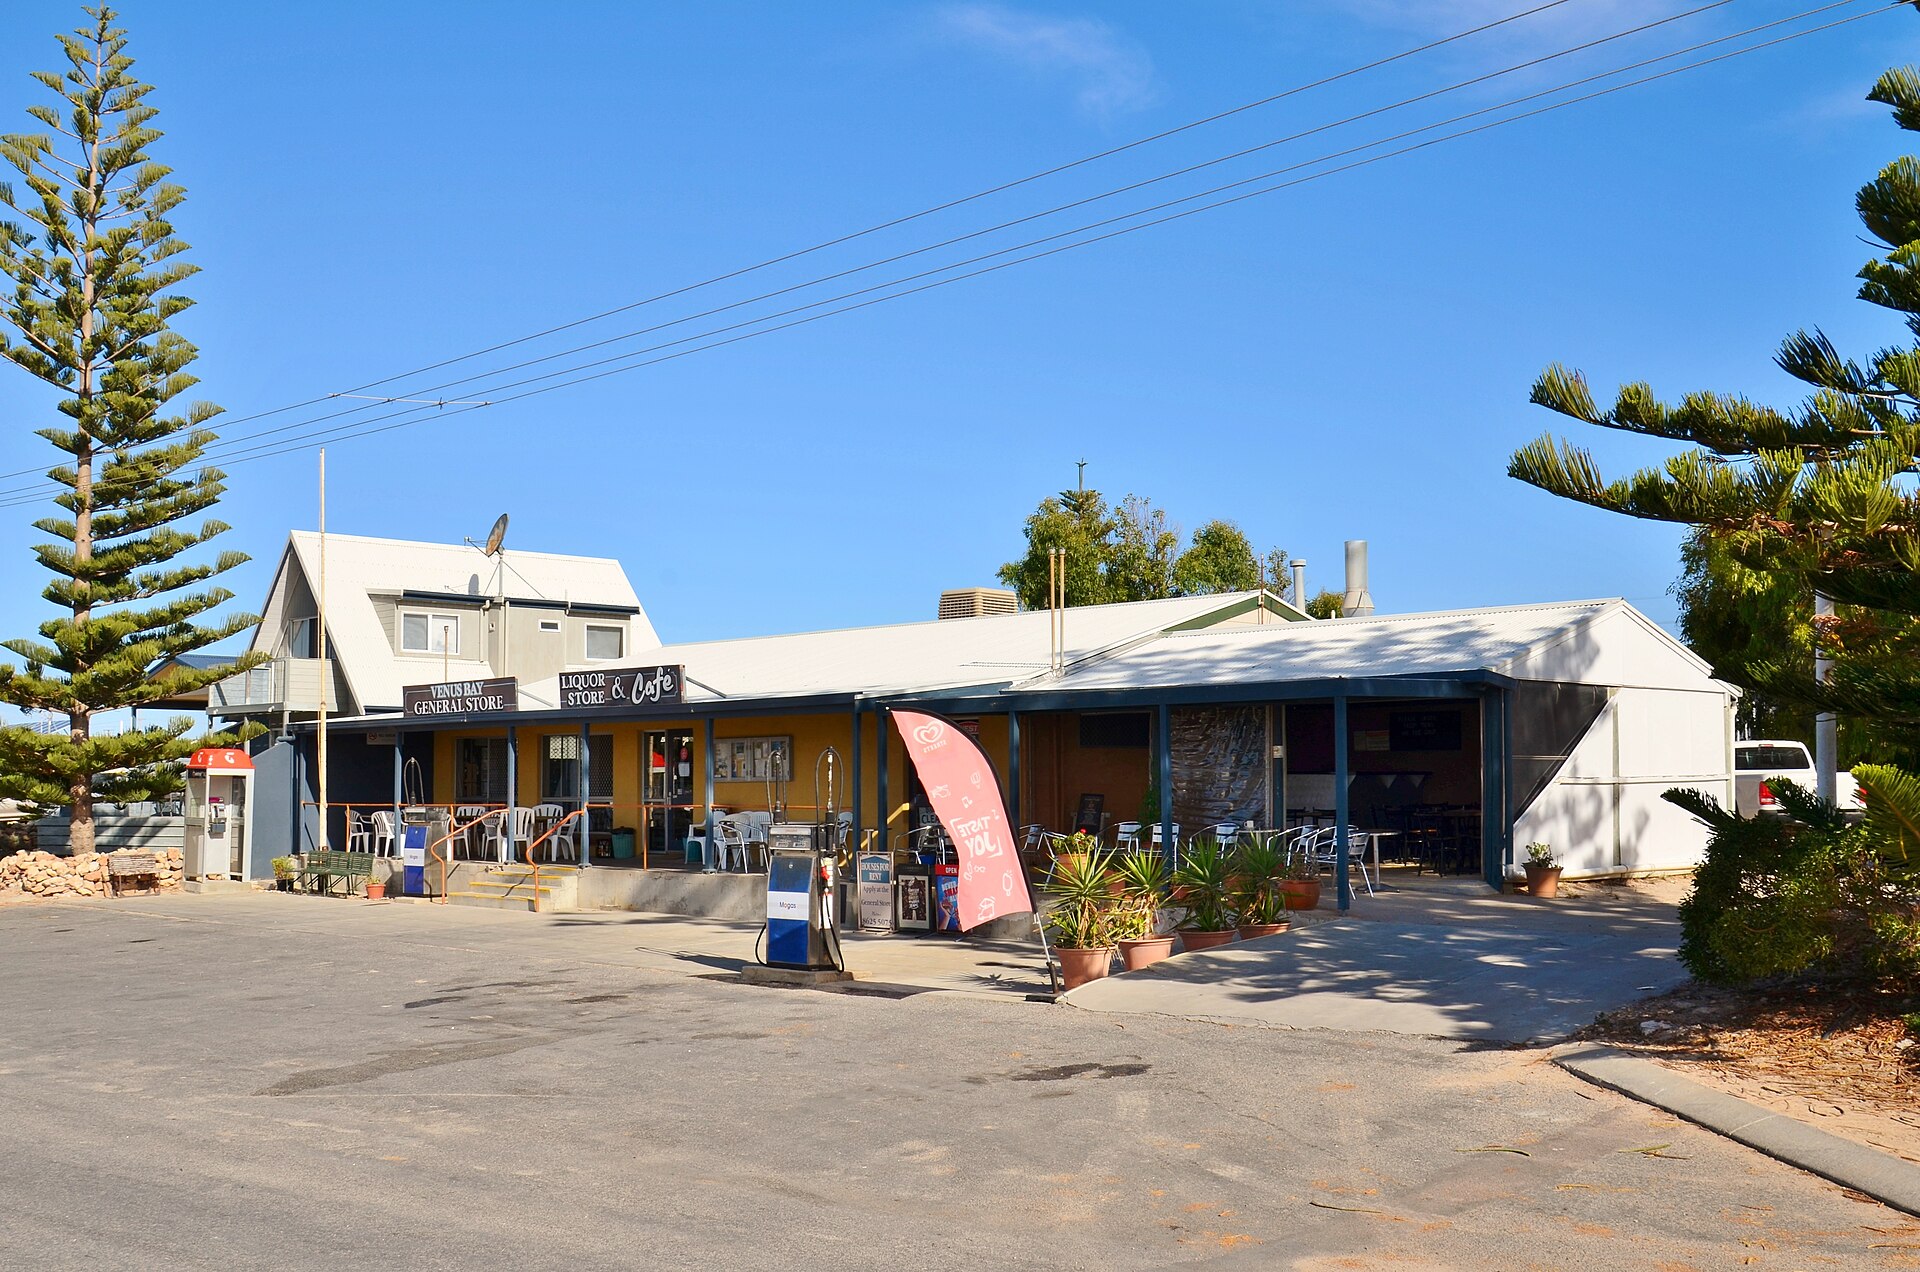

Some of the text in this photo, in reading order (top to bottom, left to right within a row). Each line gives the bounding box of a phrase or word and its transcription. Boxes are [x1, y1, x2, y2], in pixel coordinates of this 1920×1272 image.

[561, 672, 606, 690] LIQUOR
[611, 666, 674, 705] & Café
[430, 681, 484, 698] VENUS BAY
[414, 695, 504, 715] GENERAL STORE
[567, 690, 606, 706] STORE
[861, 862, 890, 871] HOUSES FOR
[869, 872, 882, 881] RENT
[864, 886, 876, 894] Apply
[779, 901, 797, 910] Mogas
